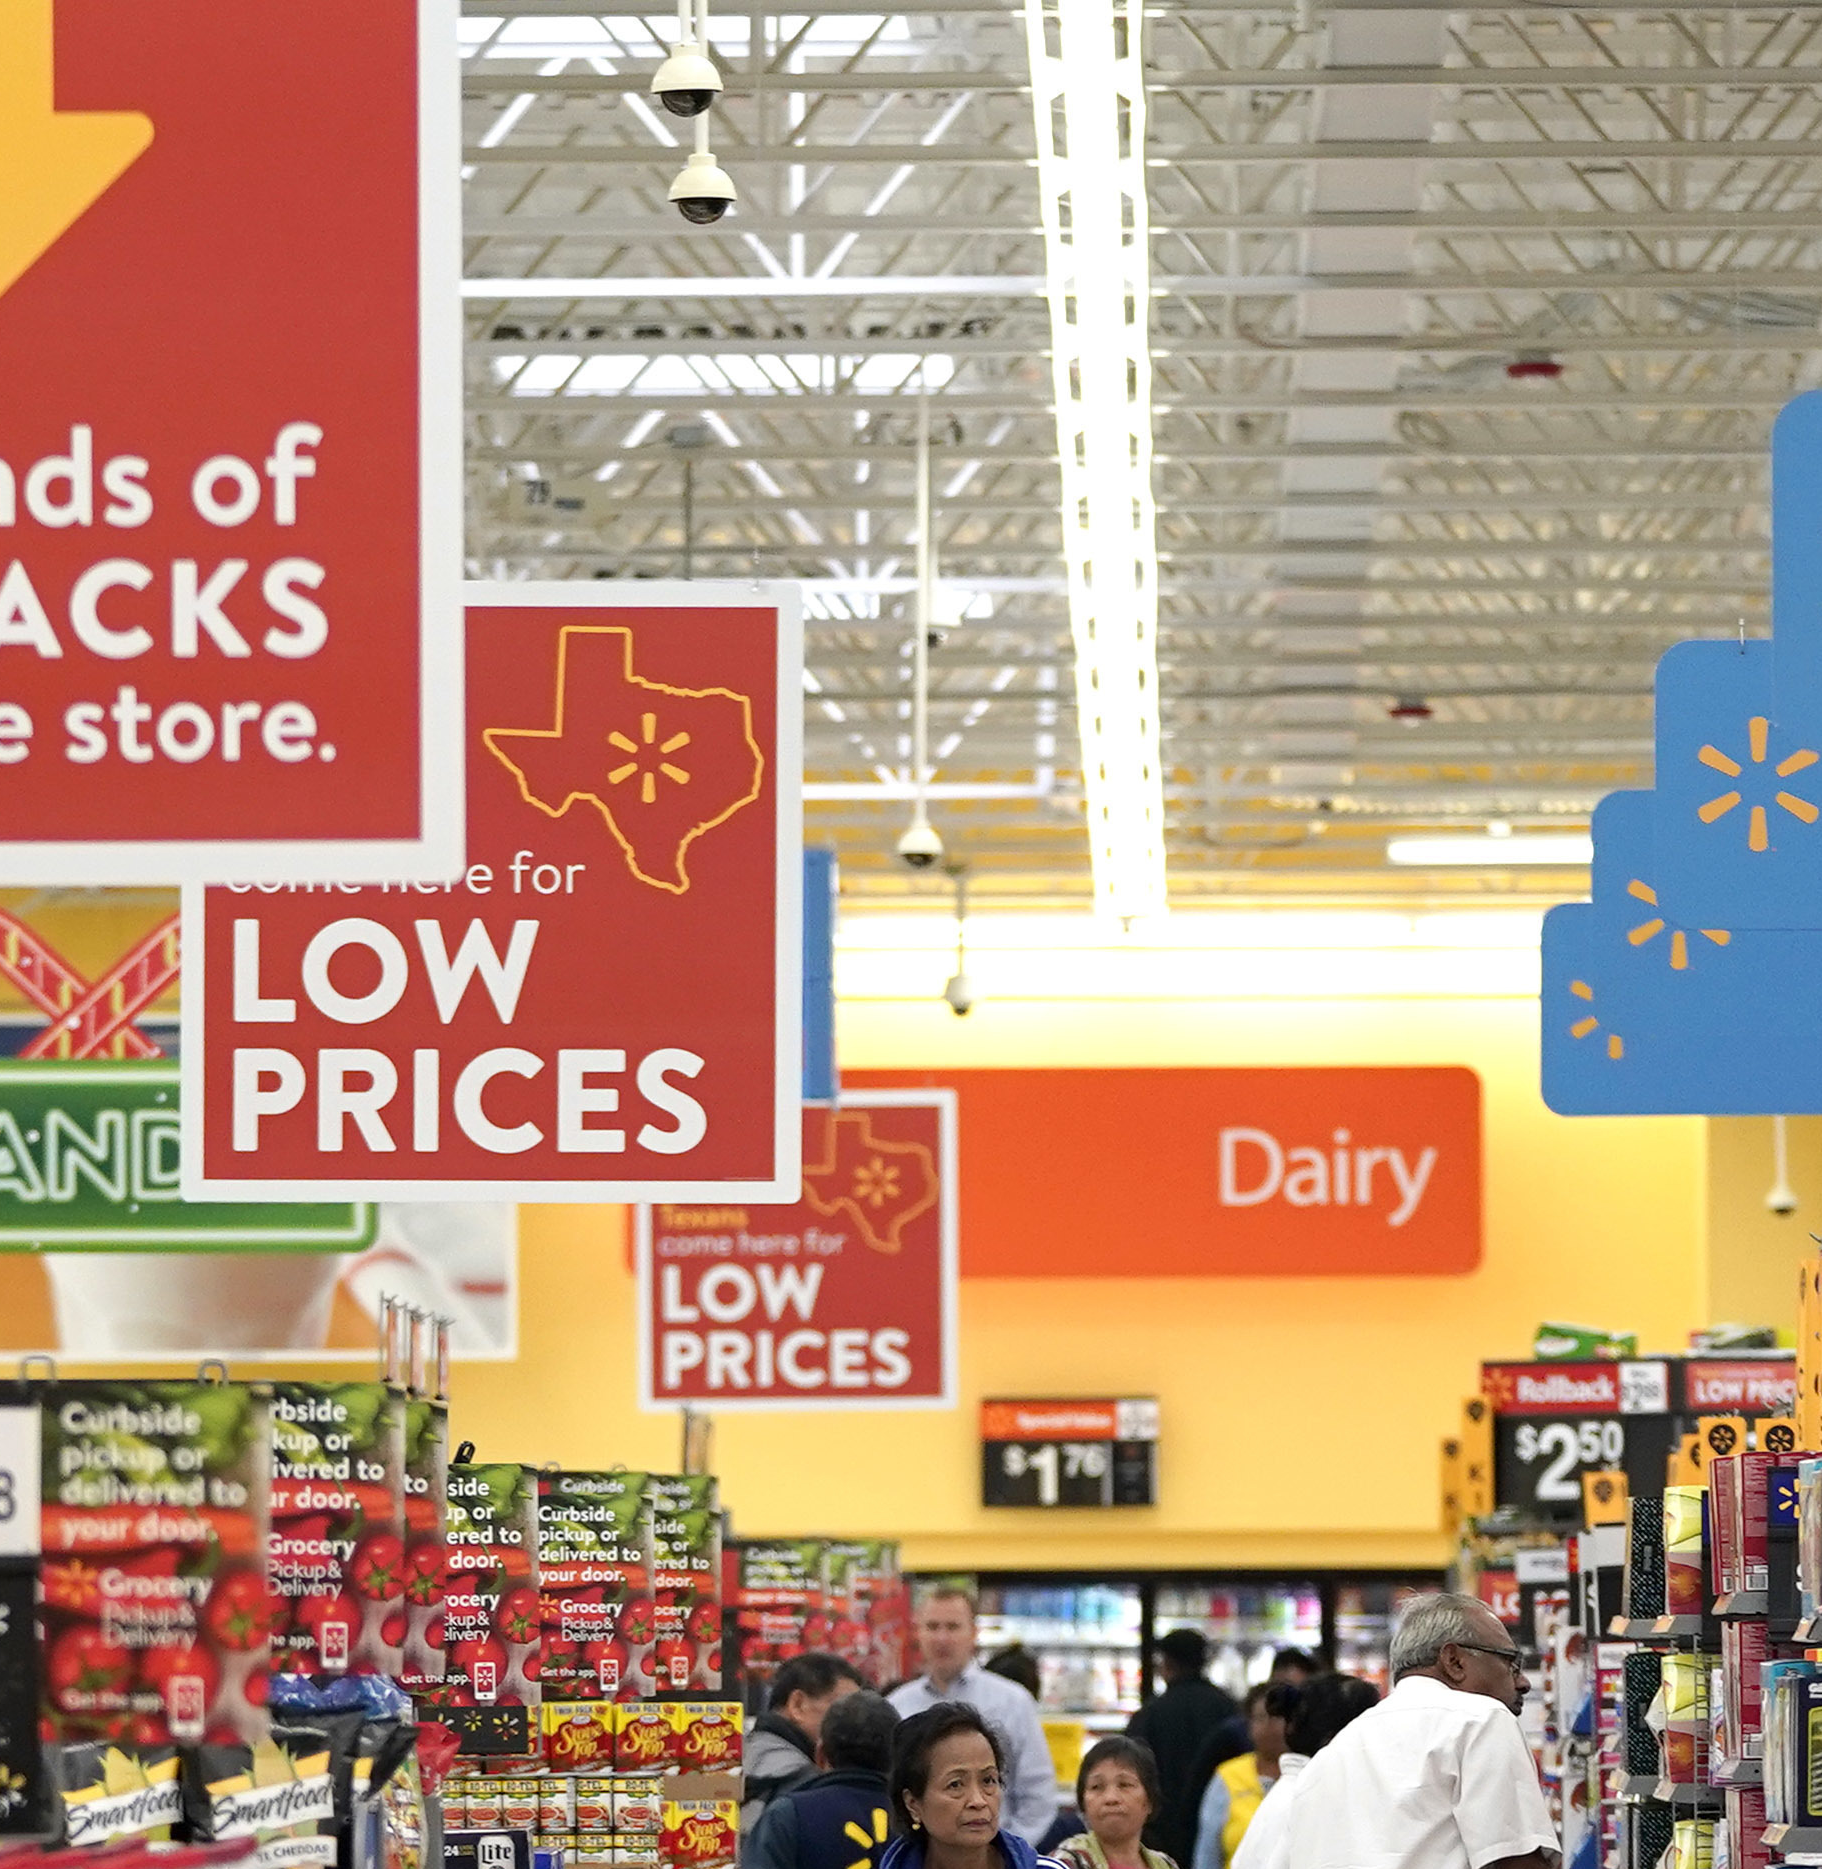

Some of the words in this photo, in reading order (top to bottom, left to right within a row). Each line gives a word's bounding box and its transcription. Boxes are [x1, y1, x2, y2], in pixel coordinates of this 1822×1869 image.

[190, 421, 325, 528] of
[63, 685, 338, 766] store.
[509, 849, 585, 895] for
[233, 917, 540, 1025] LOW
[233, 1047, 708, 1155] PRICES
[1216, 1125, 1439, 1227] Dairy
[657, 1235, 735, 1257] come
[737, 1229, 801, 1257] here
[803, 1226, 847, 1256] for
[661, 1262, 825, 1324] LOW
[661, 1327, 913, 1390] PRICES
[1515, 1373, 1616, 1404] Rollback
[1694, 1379, 1743, 1403] LOW
[59, 1400, 203, 1436] Curbside
[268, 1398, 348, 1424] rbside
[324, 1432, 354, 1452] or
[59, 1437, 167, 1477] pickup
[171, 1446, 209, 1472] or
[1514, 1420, 1625, 1501] $250
[356, 1459, 386, 1482] to
[59, 1474, 206, 1507] delivered
[210, 1476, 248, 1508] to
[405, 1473, 429, 1494] to
[560, 1477, 626, 1495] Curbside
[294, 1484, 363, 1511] door.
[472, 1506, 496, 1521] or
[538, 1504, 616, 1522] Curbside
[59, 1518, 134, 1550] your
[498, 1528, 522, 1545] to
[538, 1526, 597, 1545] pickup
[600, 1529, 621, 1543] or
[672, 1539, 691, 1553] or
[267, 1533, 356, 1563] Grocery
[449, 1549, 504, 1570] door.
[538, 1546, 620, 1563] delivered
[622, 1547, 642, 1563] to
[692, 1556, 711, 1571] to
[99, 1567, 215, 1608] Grocery
[538, 1570, 578, 1587] your
[580, 1566, 627, 1583] door.
[655, 1572, 696, 1588] door.
[445, 1593, 501, 1612] rocery
[560, 1598, 624, 1618] Grocery
[561, 1629, 616, 1645] Delivery
[540, 1666, 558, 1678] Get
[559, 1666, 577, 1678] the
[555, 1723, 605, 1754] Stove
[624, 1721, 673, 1754] Stove
[685, 1722, 735, 1754] Stove
[573, 1741, 599, 1760] Top
[641, 1740, 666, 1760] Top
[702, 1740, 728, 1760] Top
[212, 1780, 335, 1834] Smartfood
[679, 1819, 728, 1851] Stove
[696, 1836, 722, 1856] Top
[444, 1845, 460, 1858] 24
[481, 1843, 513, 1865] Lite
